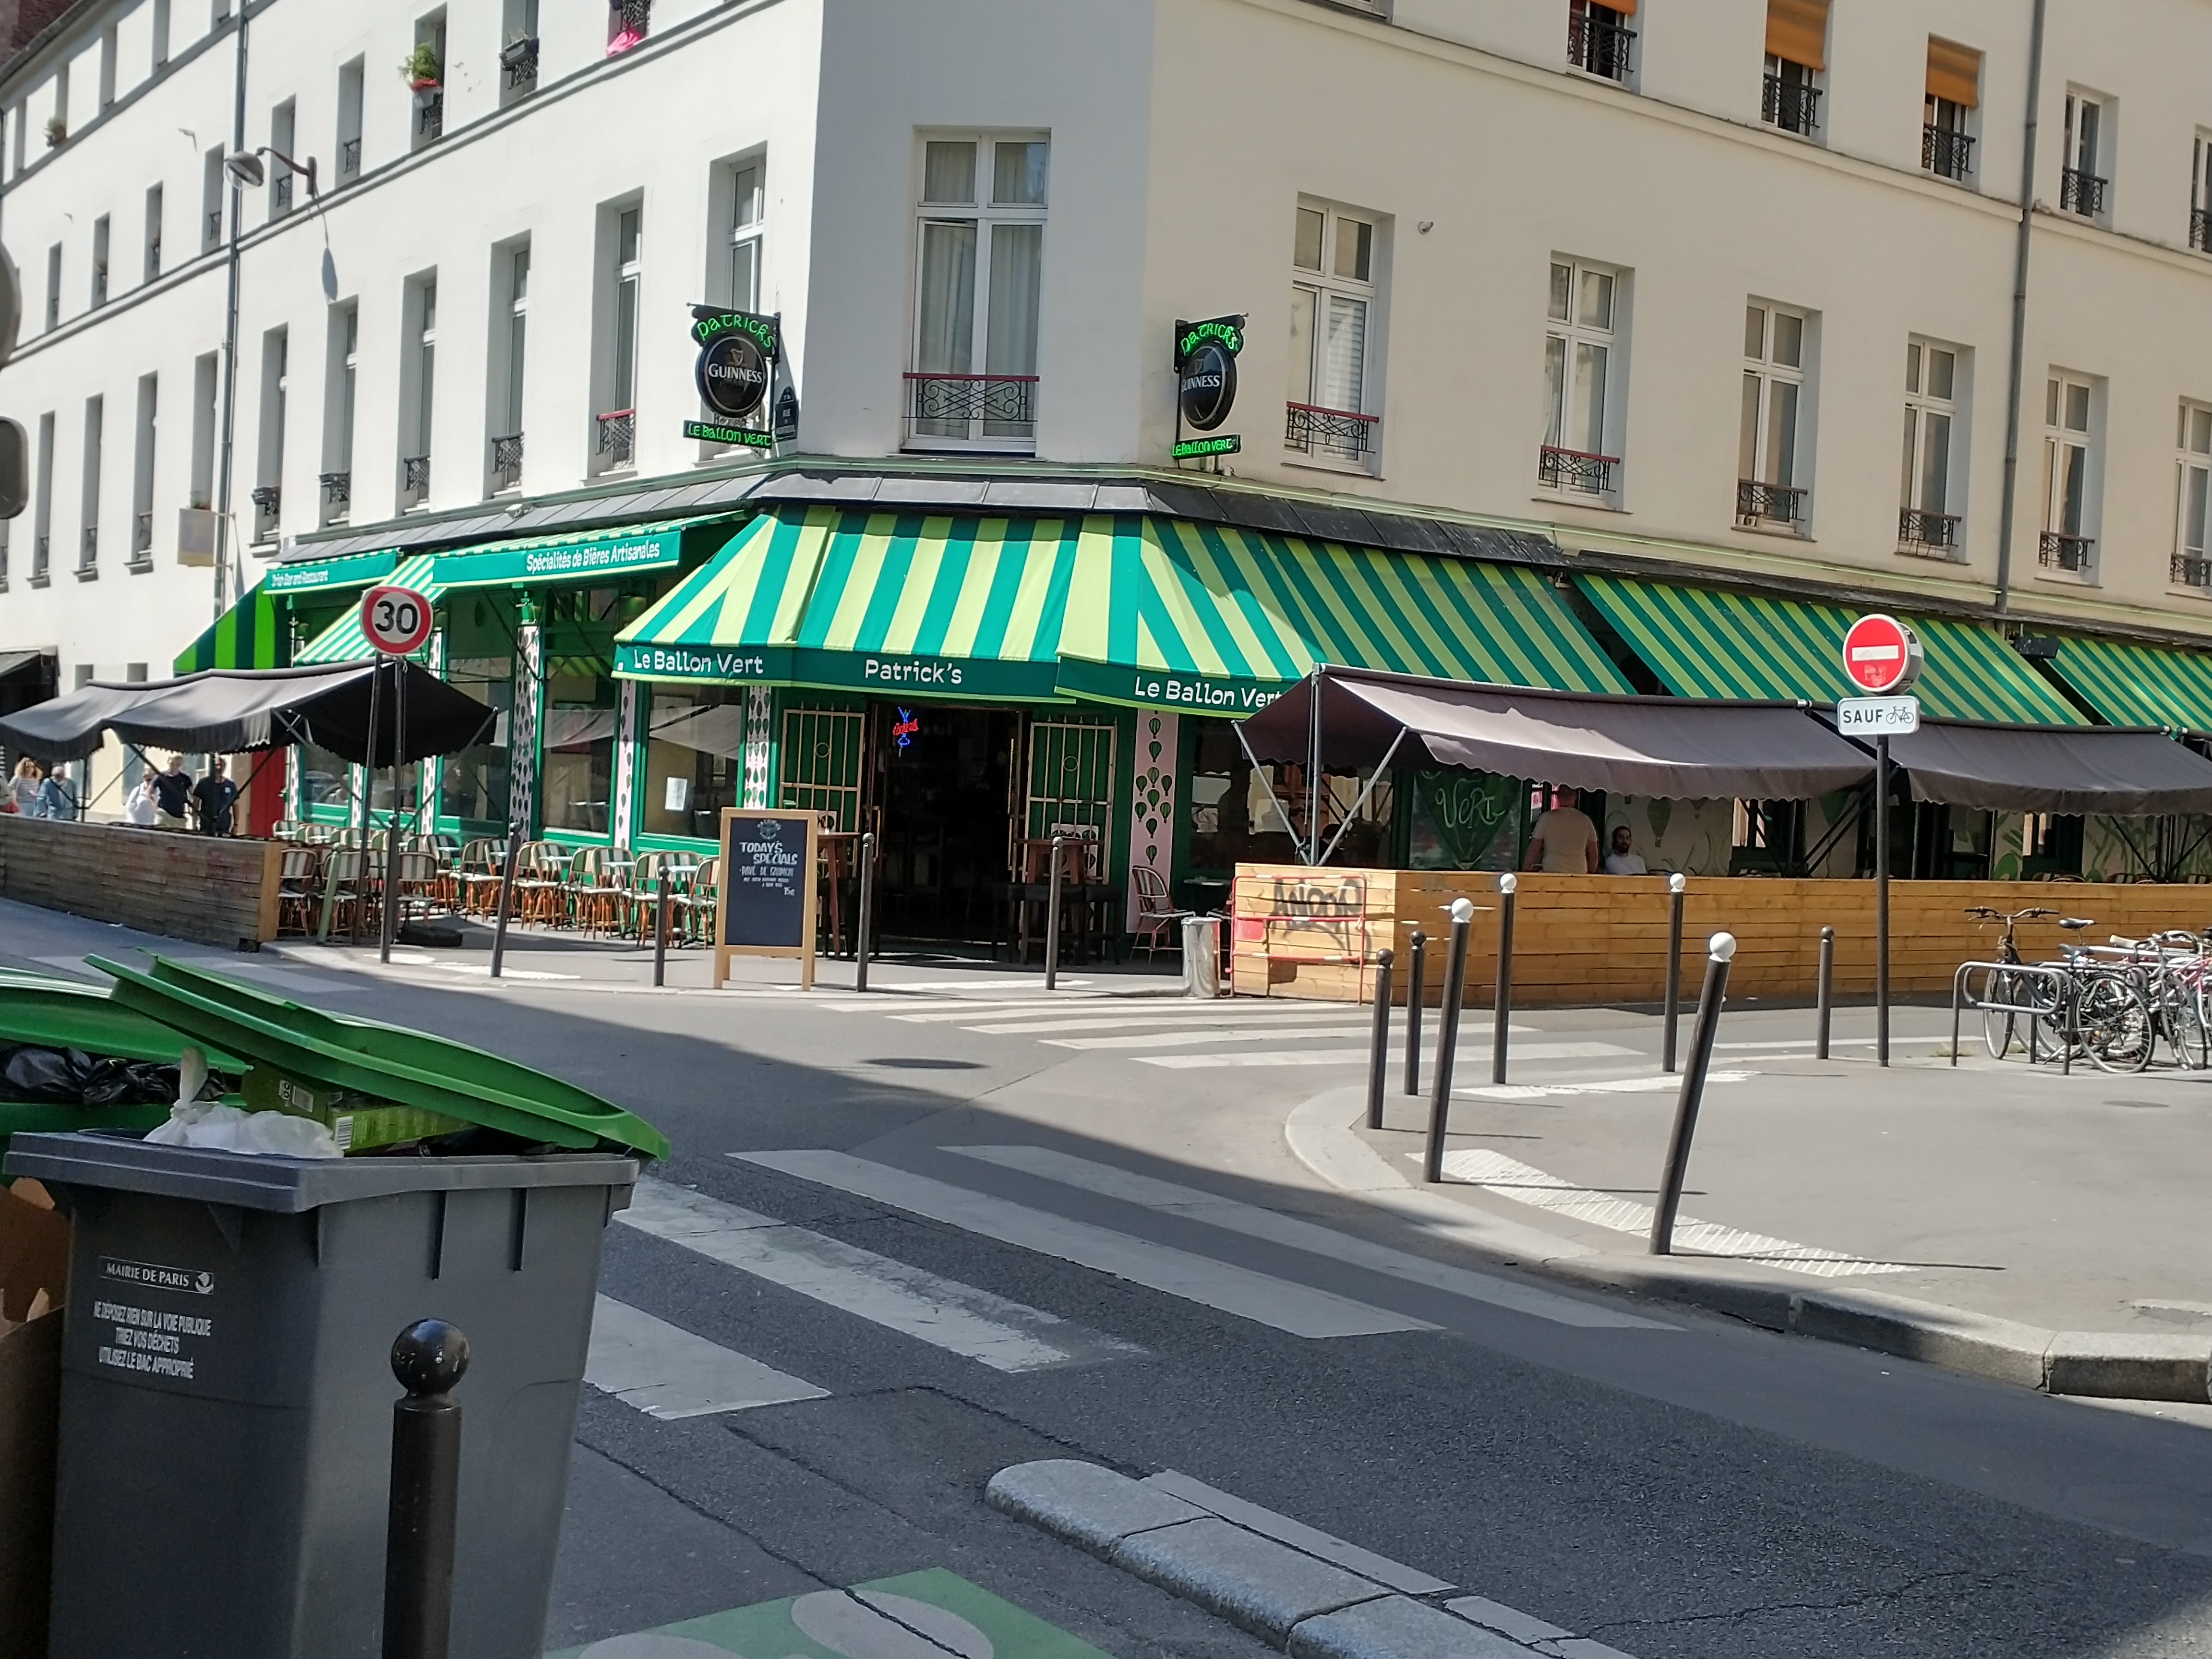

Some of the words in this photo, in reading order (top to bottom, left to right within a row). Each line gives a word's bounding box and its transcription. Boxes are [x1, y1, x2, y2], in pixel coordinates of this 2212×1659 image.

[708, 363, 763, 384] GUINNESS
[688, 423, 701, 436] LE
[744, 433, 771, 446] VERT
[572, 548, 582, 567] de
[610, 539, 660, 563] Artisanales
[374, 601, 418, 635] 30
[634, 649, 650, 669] Le
[654, 650, 712, 673] Ballon
[717, 653, 764, 674] Vert
[865, 659, 962, 685] Patrick's
[1135, 676, 1160, 697] Le
[1166, 680, 1235, 706] Ballon
[1843, 709, 1883, 723] SAUF
[753, 853, 798, 865] SPECIALS
[106, 1262, 140, 1279] MAIRIE
[143, 1269, 156, 1282] DE
[159, 1271, 189, 1286] PARIS
